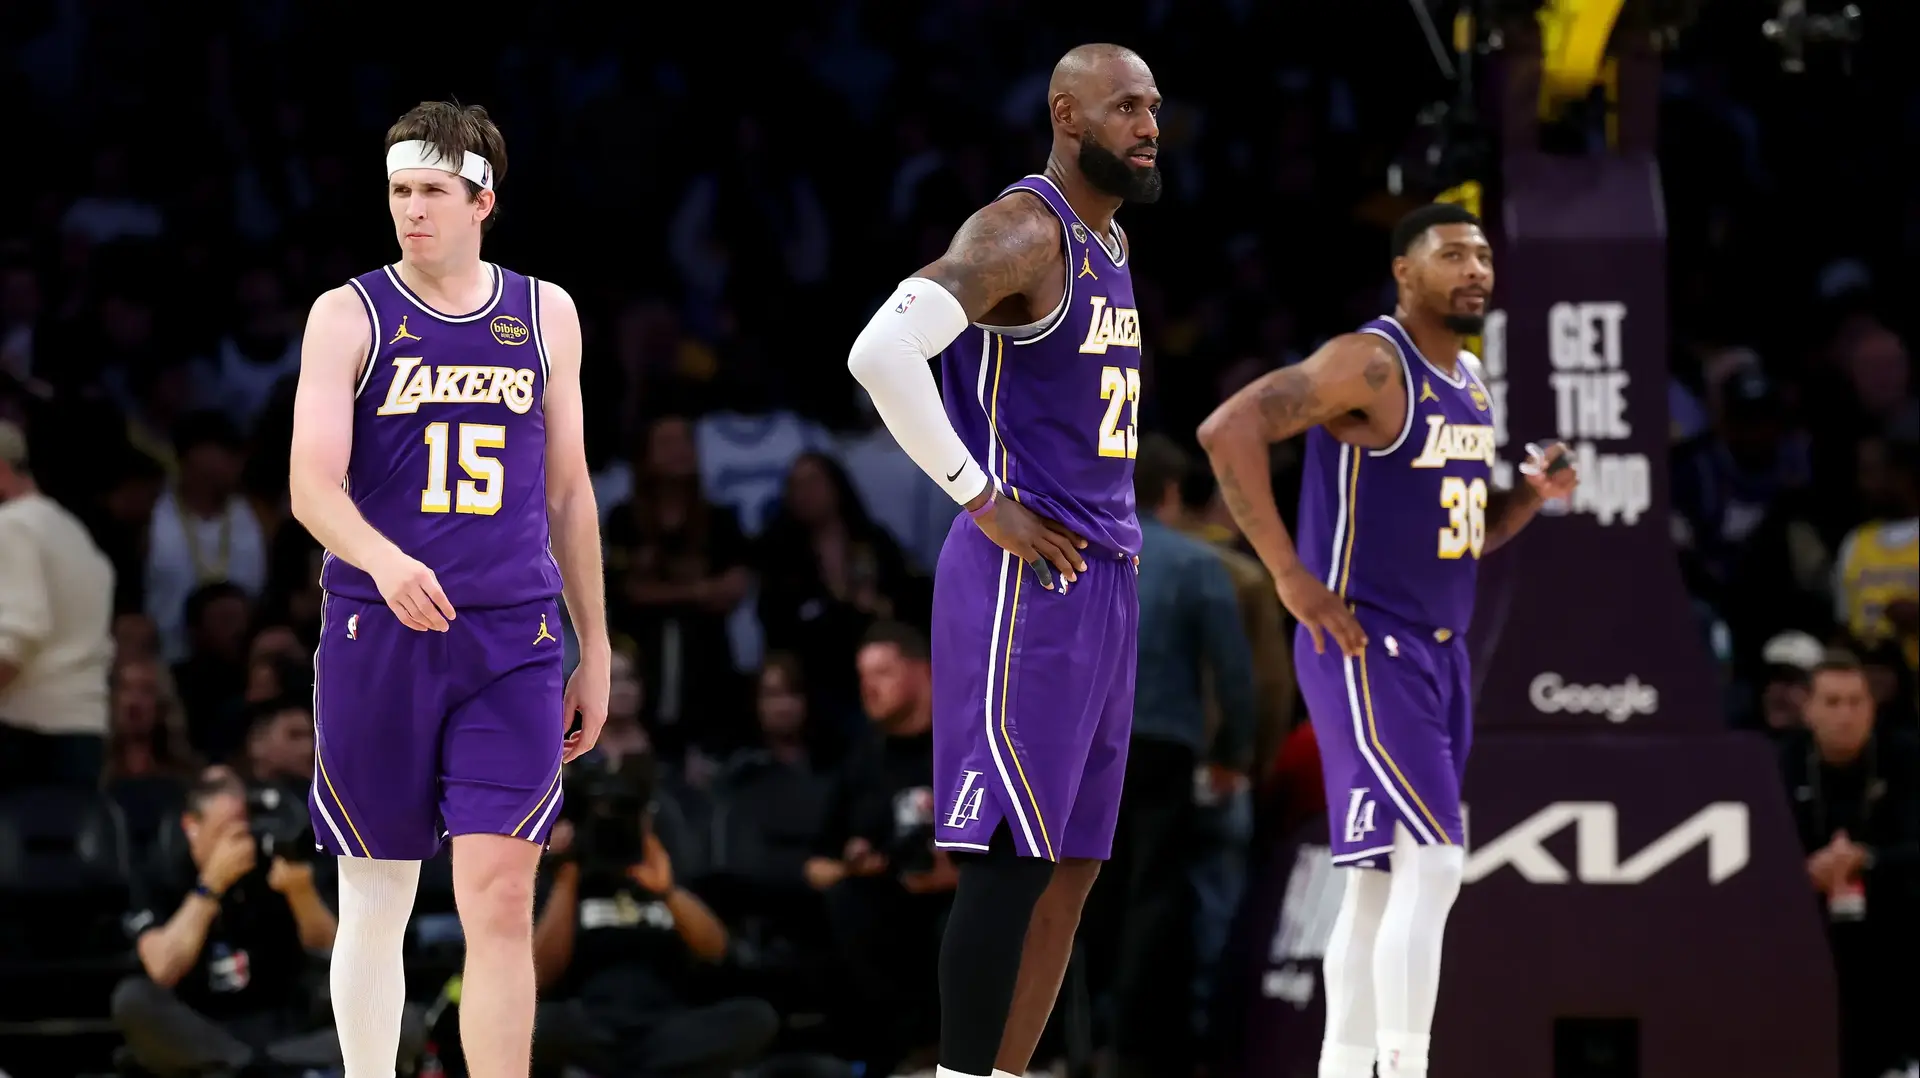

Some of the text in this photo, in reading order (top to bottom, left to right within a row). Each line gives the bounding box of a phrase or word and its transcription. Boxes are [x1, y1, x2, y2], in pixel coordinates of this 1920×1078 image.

[493, 322, 527, 338] bibigo
[1079, 295, 1141, 356] LAKE
[1549, 302, 1628, 370] GET
[376, 356, 536, 416] LAKERS
[1098, 366, 1141, 459] 23
[1548, 370, 1633, 441] THE
[421, 421, 507, 516] 15
[1572, 441, 1652, 527] App
[1437, 476, 1488, 560] 36
[1528, 671, 1660, 724] Google
[943, 769, 985, 829] LA
